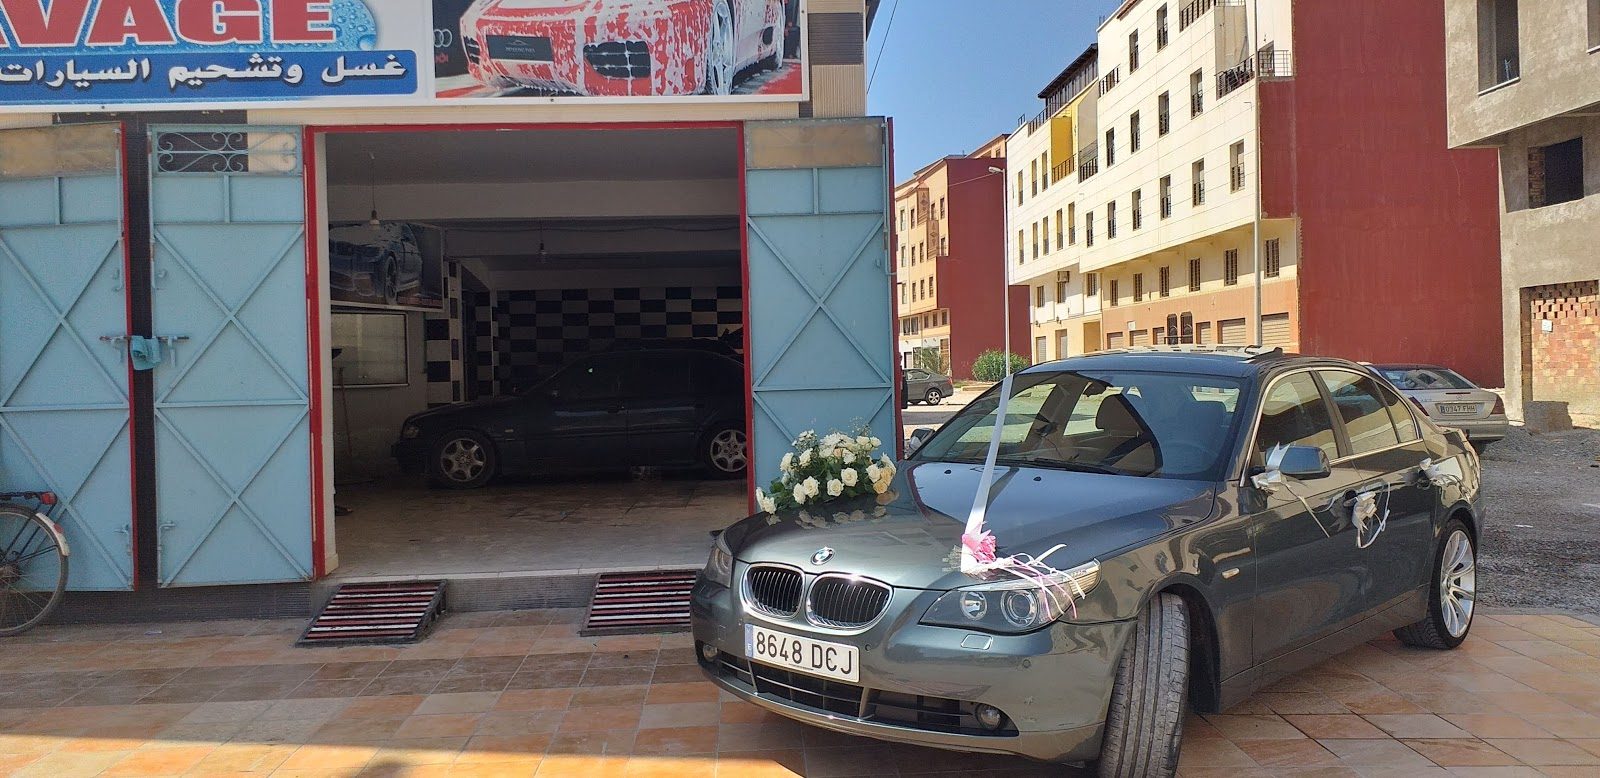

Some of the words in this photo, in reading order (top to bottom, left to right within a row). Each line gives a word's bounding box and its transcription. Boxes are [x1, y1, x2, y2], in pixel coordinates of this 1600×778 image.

[0, 0, 337, 47] VAGE
[0, 57, 151, 88] السيارات
[168, 53, 304, 89] وتشحيم
[321, 54, 407, 83] غسل
[756, 631, 802, 664] 8648
